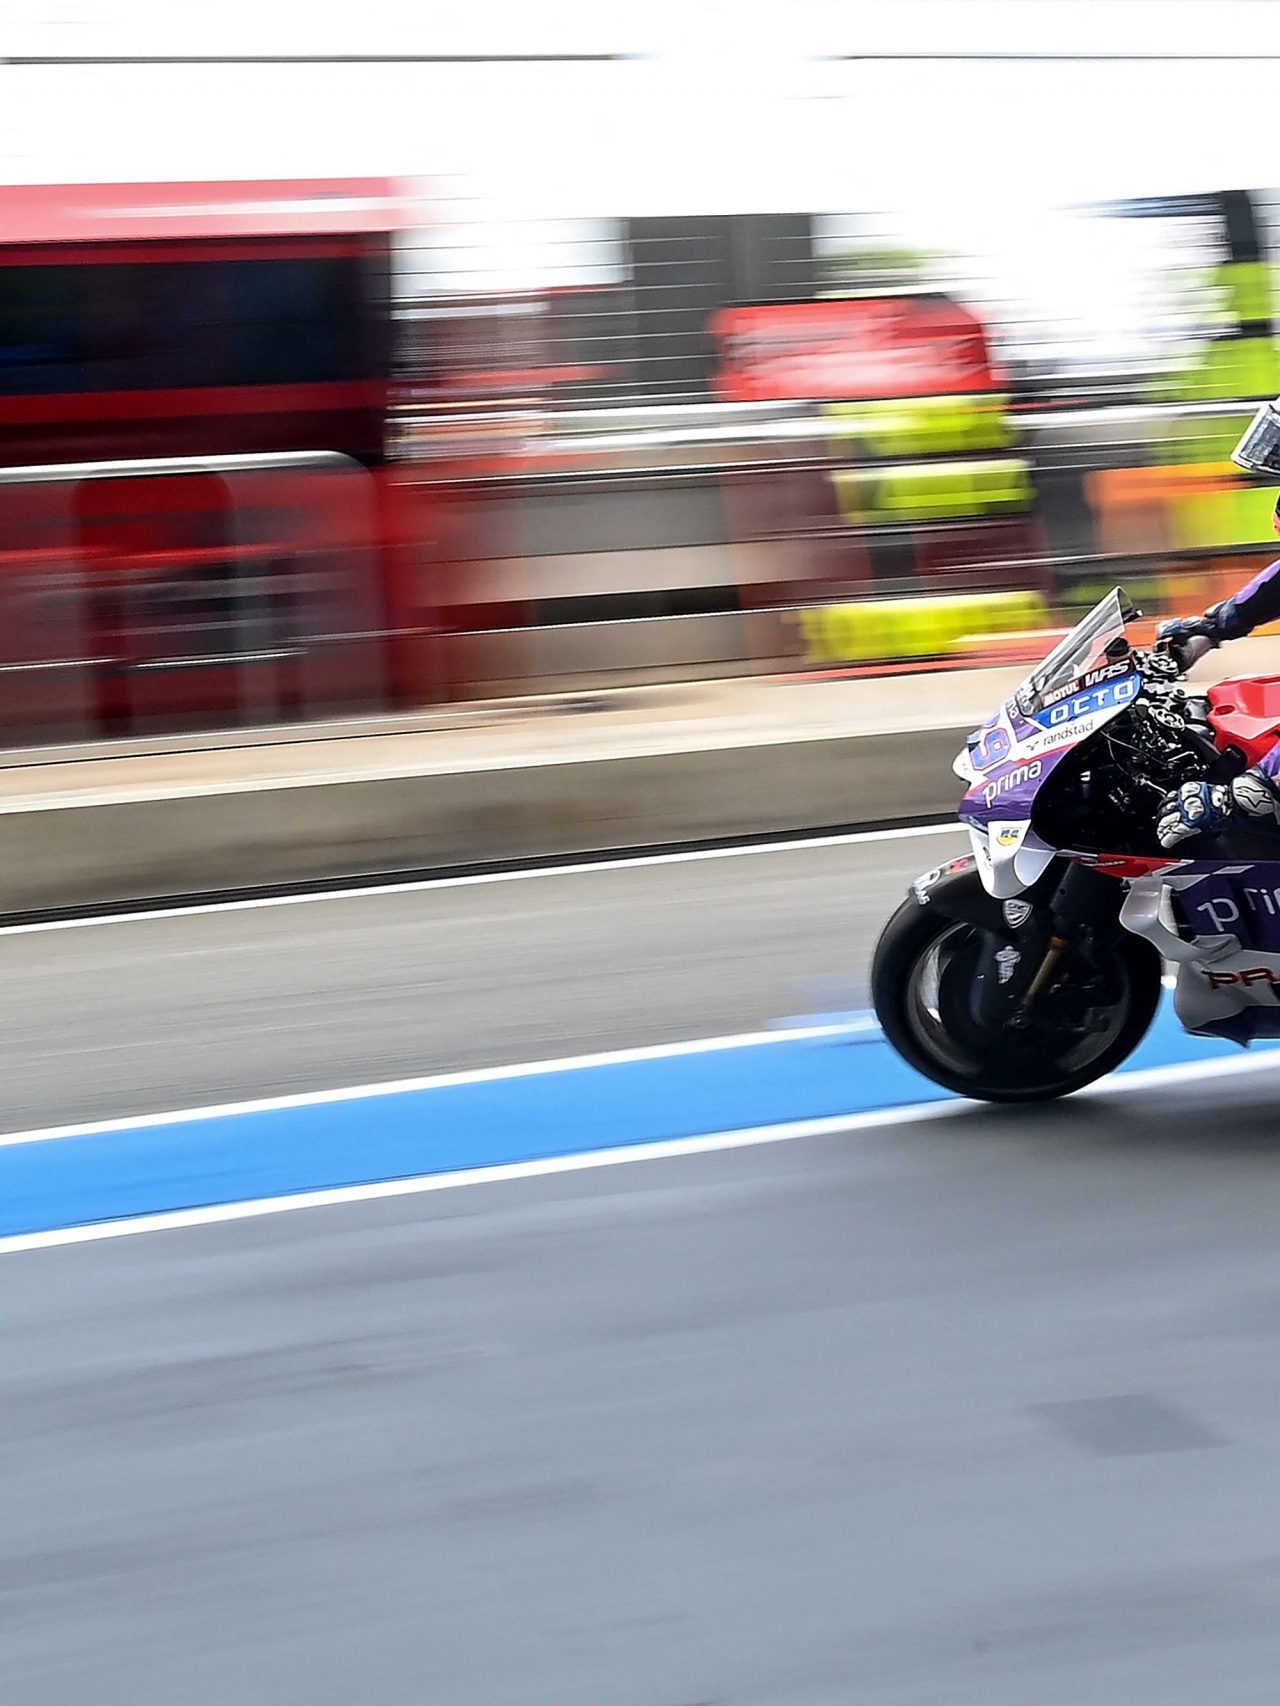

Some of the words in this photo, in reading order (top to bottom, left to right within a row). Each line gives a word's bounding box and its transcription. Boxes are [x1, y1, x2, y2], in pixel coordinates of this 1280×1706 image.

[1050, 680, 1135, 725] OCTO
[1043, 719, 1094, 746] randstad
[982, 760, 1042, 809] prima
